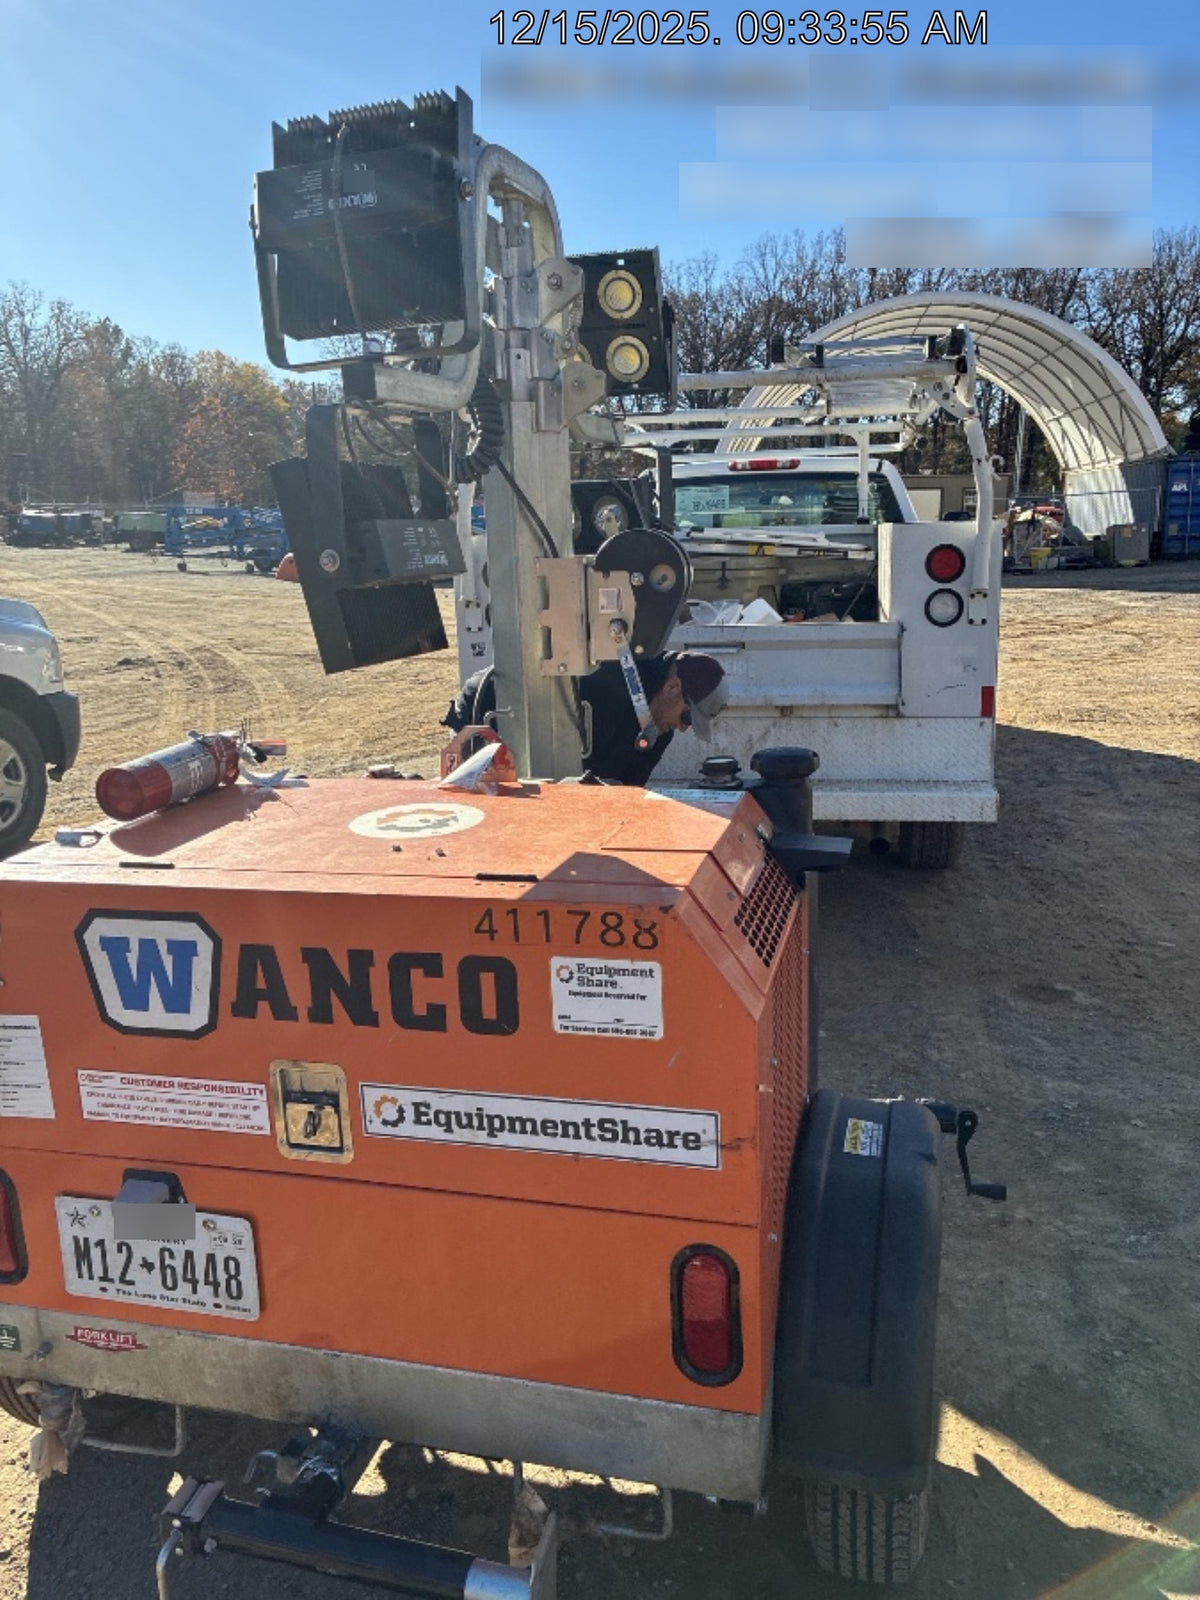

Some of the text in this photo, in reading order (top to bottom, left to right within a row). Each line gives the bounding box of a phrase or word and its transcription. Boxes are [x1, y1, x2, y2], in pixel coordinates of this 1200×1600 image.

[474, 907, 660, 950] 411788
[99, 935, 520, 1037] WANCO
[576, 963, 655, 979] Equipment
[120, 1076, 175, 1089] CUSTOMER
[176, 1080, 265, 1097] RESPONSIBILITY
[411, 1101, 702, 1151] EquipmentShare
[76, 1328, 134, 1345] FORKLIFT
